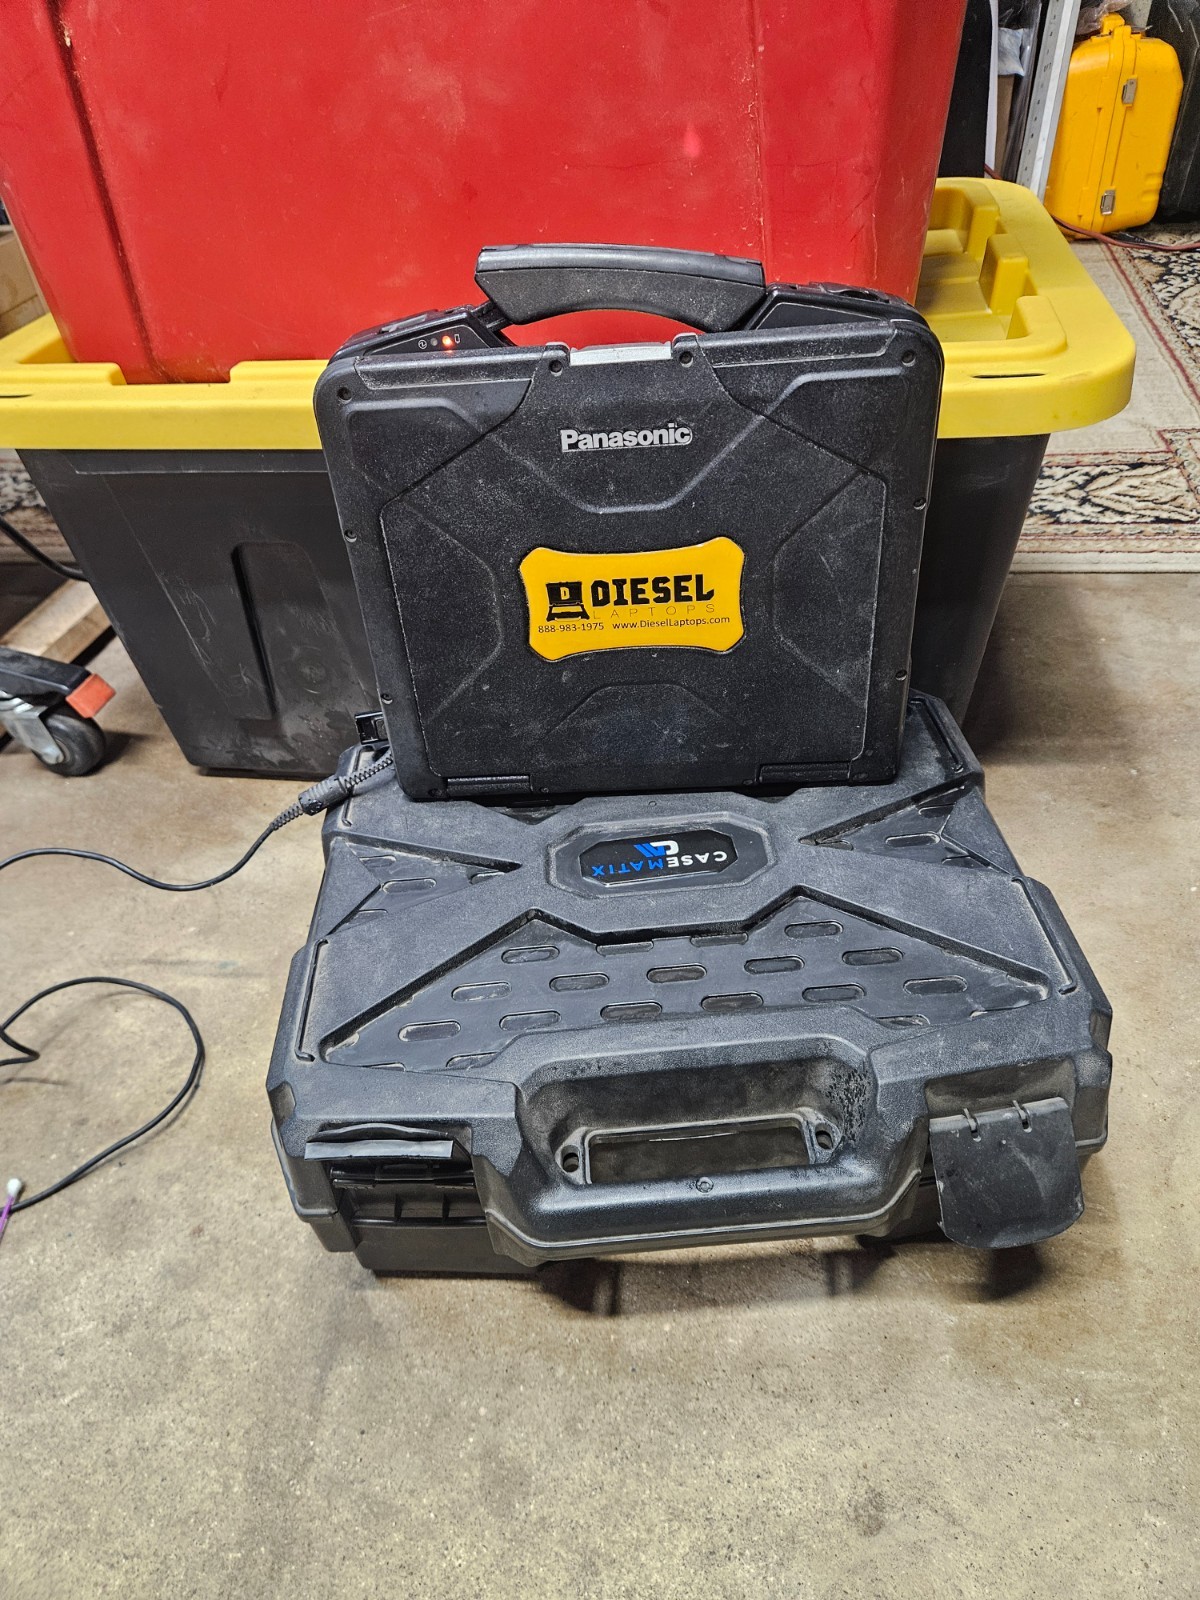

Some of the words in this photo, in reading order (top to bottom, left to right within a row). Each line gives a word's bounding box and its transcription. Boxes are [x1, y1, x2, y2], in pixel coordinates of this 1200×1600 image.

[560, 423, 693, 450] Panasonic
[590, 574, 714, 607] DIESEL
[593, 603, 715, 619] LAPTOPS
[538, 622, 604, 633] 888-983-1975
[612, 615, 730, 630] www.DieselLaptops.com
